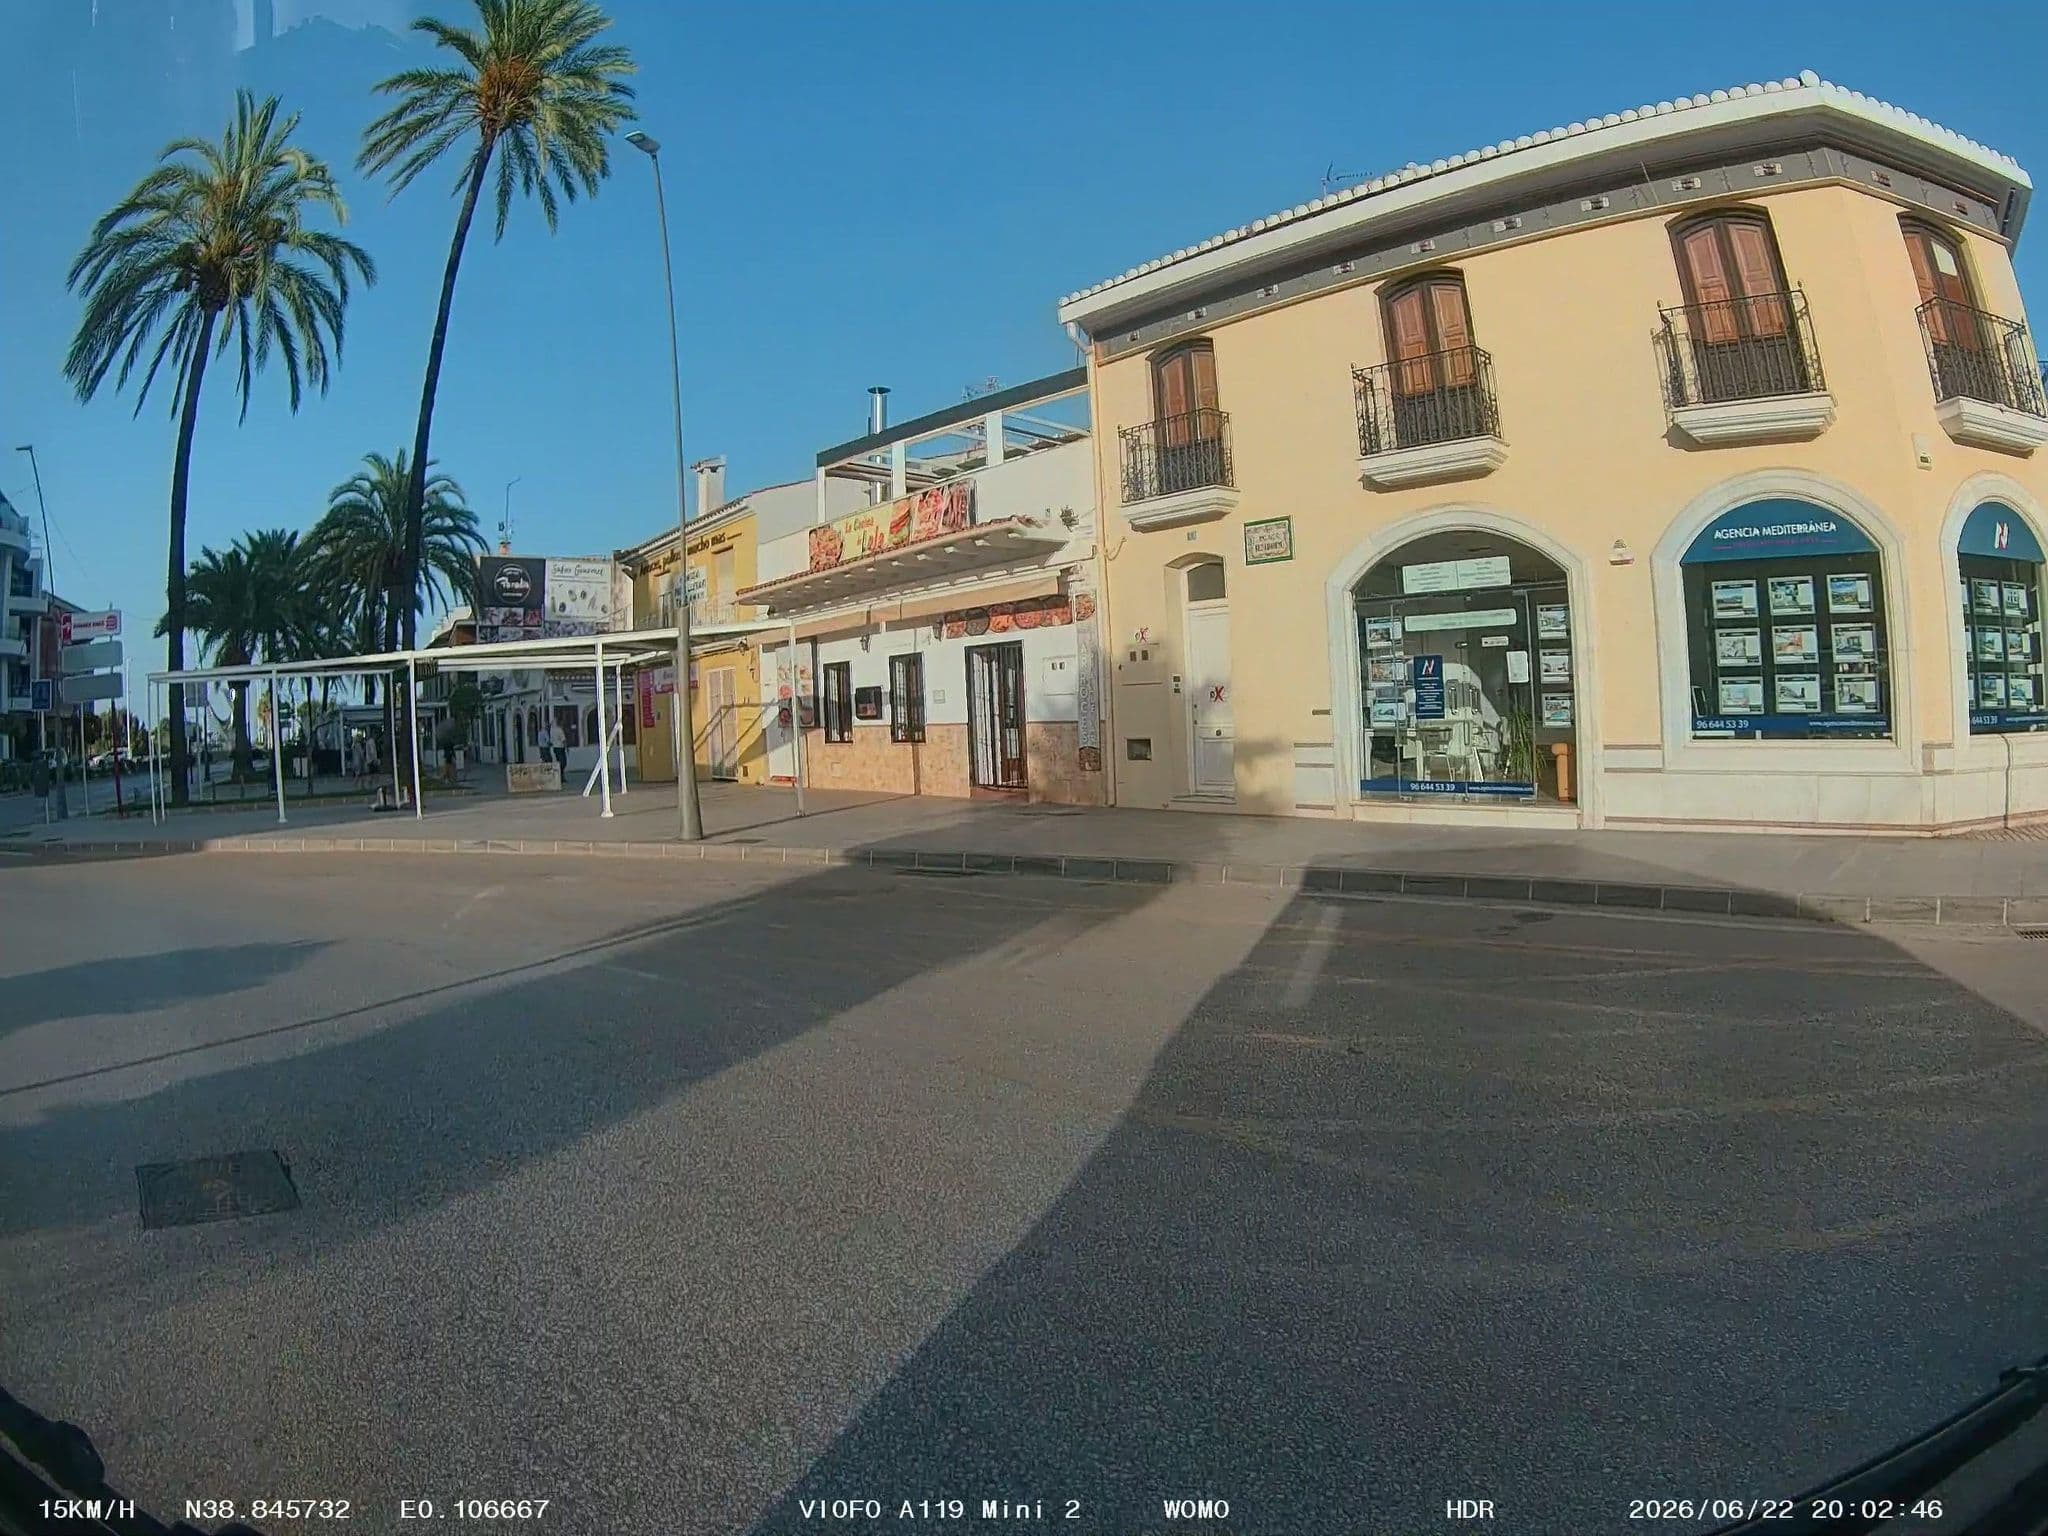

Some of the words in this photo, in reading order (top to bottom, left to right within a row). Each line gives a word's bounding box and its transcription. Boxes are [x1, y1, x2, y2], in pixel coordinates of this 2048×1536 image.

[1714, 528, 1760, 540] AGENCIA
[1761, 520, 1837, 537] MEDITERRÁNEA
[1696, 719, 1708, 730] 96
[1708, 719, 1725, 729] 644
[1726, 719, 1737, 729] 53
[1738, 719, 1750, 729] 39
[1421, 782, 1435, 791] 644
[1436, 783, 1445, 792] 53
